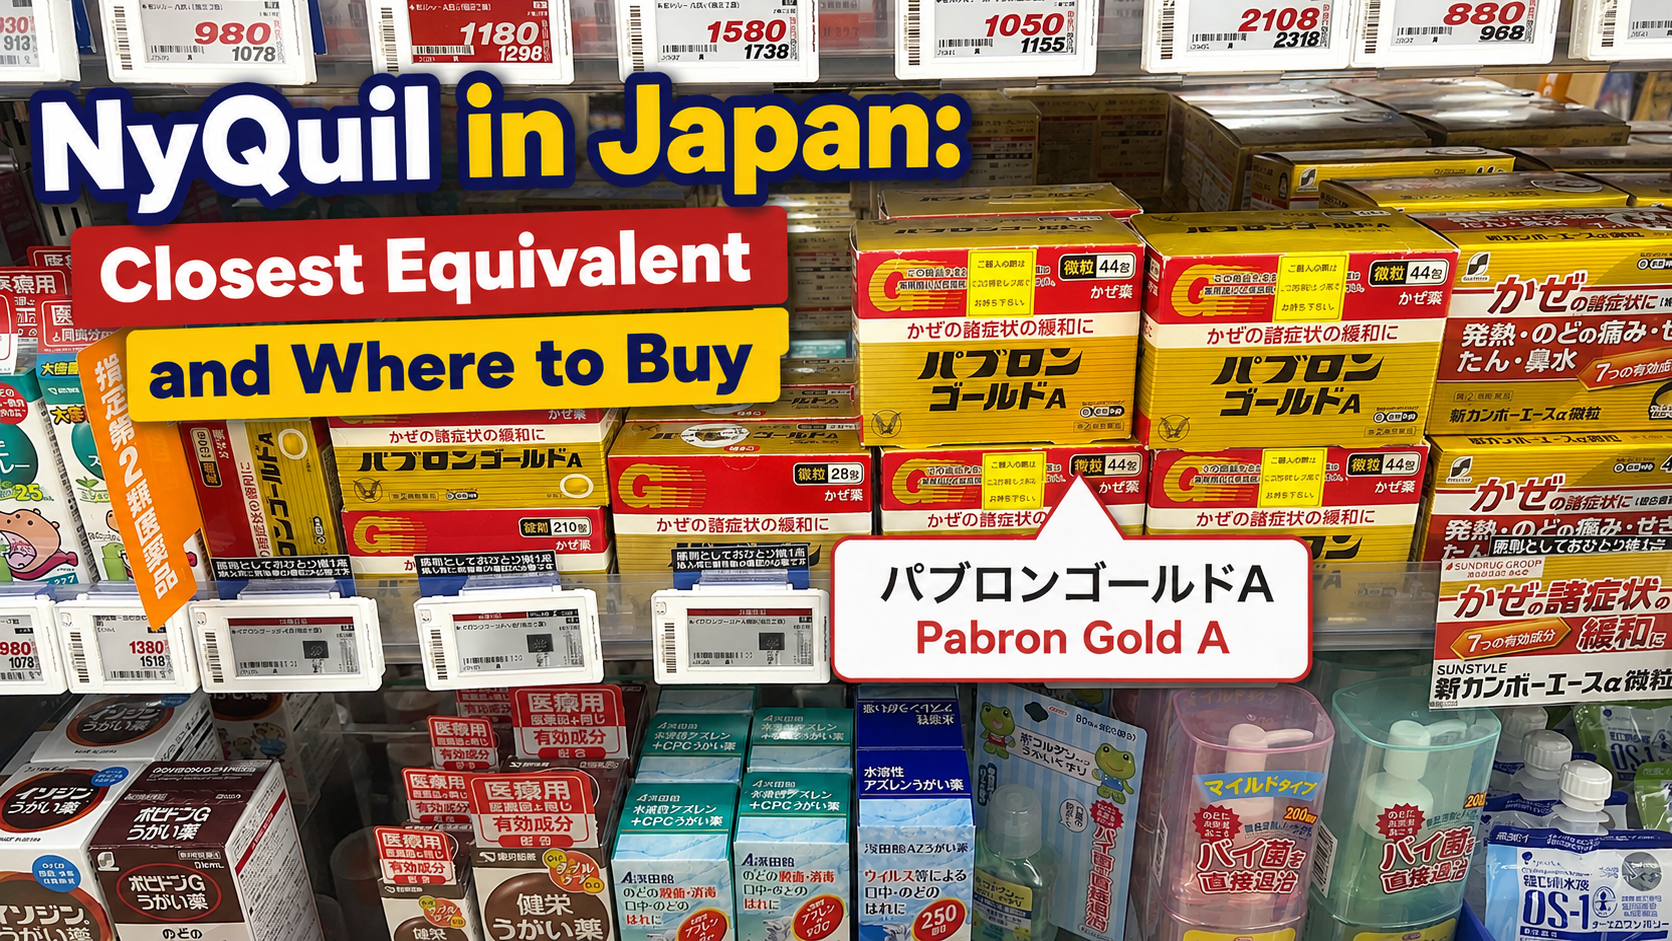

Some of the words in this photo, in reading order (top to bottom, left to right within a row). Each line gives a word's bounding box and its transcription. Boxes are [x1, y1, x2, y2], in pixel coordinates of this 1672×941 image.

[984, 13, 1065, 37] 1050
[1238, 8, 1321, 32] 2108
[1443, 1, 1527, 26] 880
[193, 22, 272, 45] 980
[459, 22, 539, 46] 1180
[707, 19, 786, 43] 1580
[1273, 32, 1320, 48] 2318
[1479, 25, 1525, 40] 968
[231, 46, 276, 62] 1078
[498, 45, 543, 62] 1298
[744, 43, 789, 60] 1738
[1020, 37, 1065, 53] 1155
[1486, 270, 1659, 314] かぜの諸症状に
[917, 347, 1083, 380] パブロン
[1210, 353, 1386, 386] パブロン
[1456, 347, 1578, 374] たん・鼻水
[929, 381, 1067, 412] ゴールドA
[1219, 386, 1361, 417] ゴールドA
[1469, 473, 1634, 512] かぜの諸症状に
[1453, 576, 1670, 618] かぜの諸症状の
[129, 640, 165, 655] 1380
[9, 656, 35, 669] 1078
[527, 692, 605, 714] 医療用
[1203, 775, 1319, 797] マイルドタイプ
[1196, 869, 1300, 894] 直接退治
[516, 893, 574, 916] 健栄
[865, 902, 906, 916] はれに
[1522, 889, 1589, 930] OS-1
[921, 903, 958, 931] 250
[492, 918, 604, 941] うがい薬
